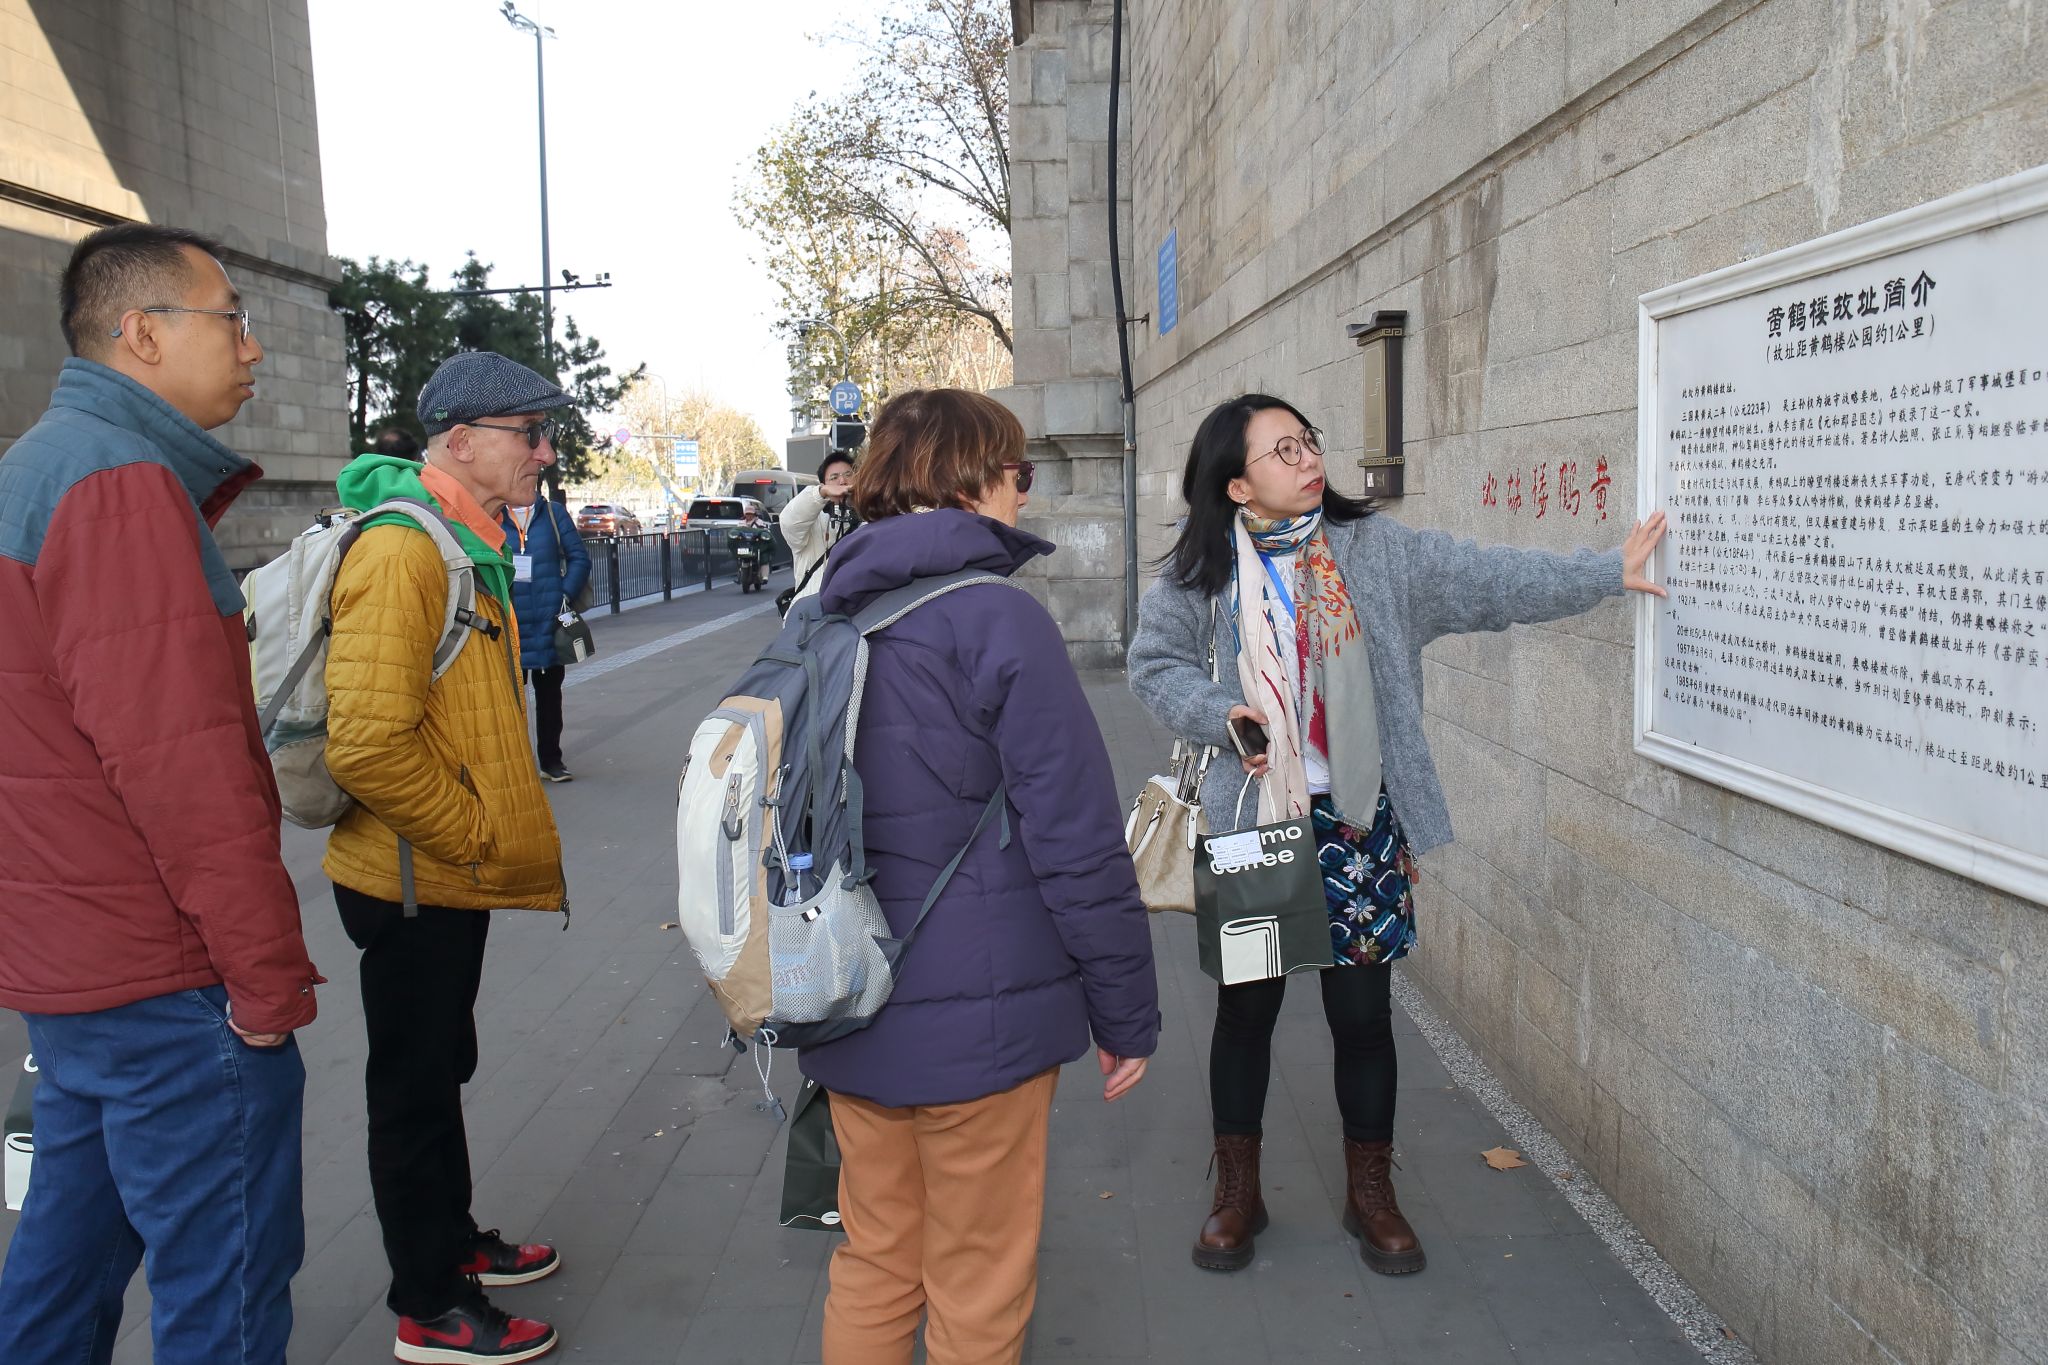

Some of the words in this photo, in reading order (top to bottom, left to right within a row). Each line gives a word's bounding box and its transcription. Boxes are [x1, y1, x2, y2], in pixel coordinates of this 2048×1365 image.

[1766, 270, 1936, 338] 黄鹤楼故址简介
[1765, 314, 1937, 364] （故址距黄鹤楼公园约1公里）
